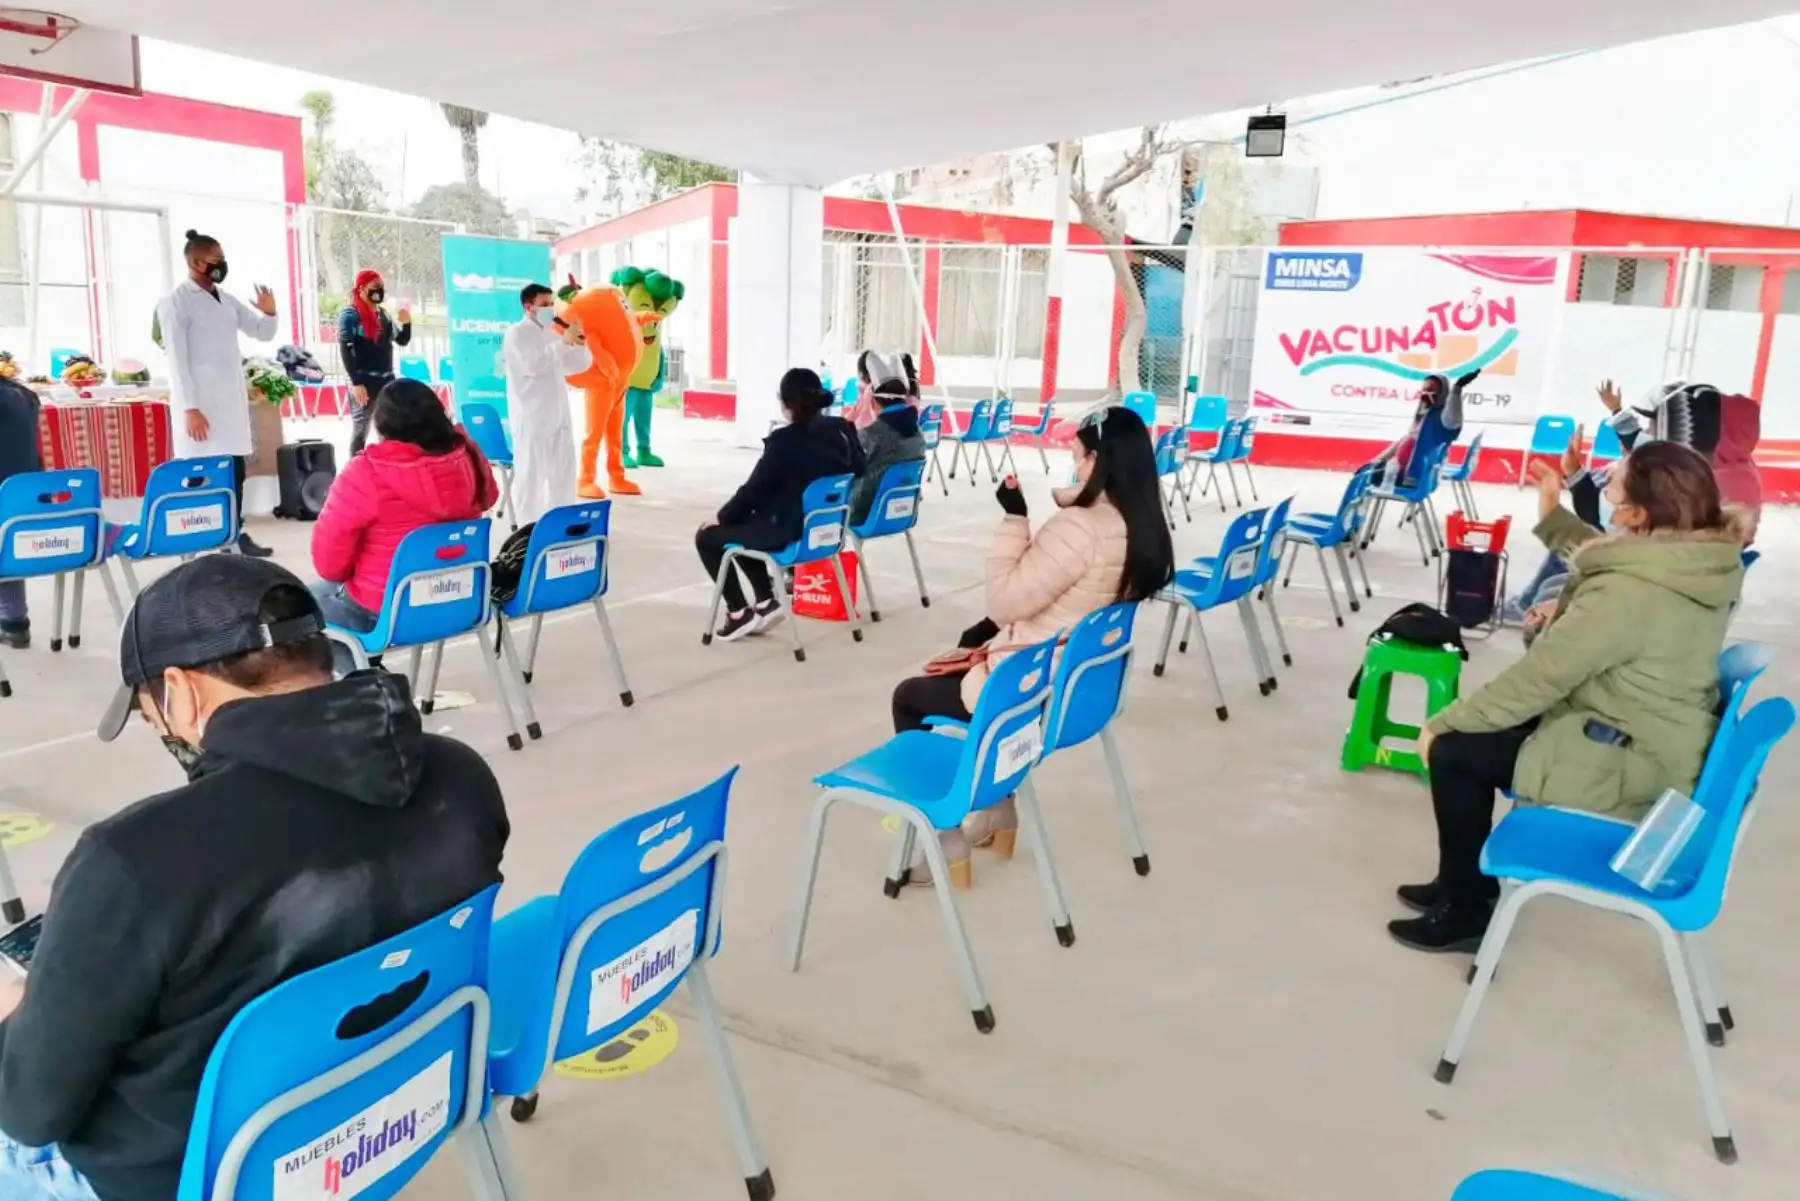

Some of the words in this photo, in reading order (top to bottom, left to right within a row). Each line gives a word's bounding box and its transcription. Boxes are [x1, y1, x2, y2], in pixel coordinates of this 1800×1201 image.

[1275, 257, 1350, 278] MINSA
[1331, 383, 1399, 401] CONTRA
[597, 946, 649, 985] MUEBLES
[620, 945, 676, 1005] holiday
[284, 1116, 368, 1174] MUEBLES
[323, 1108, 418, 1196] holiday
